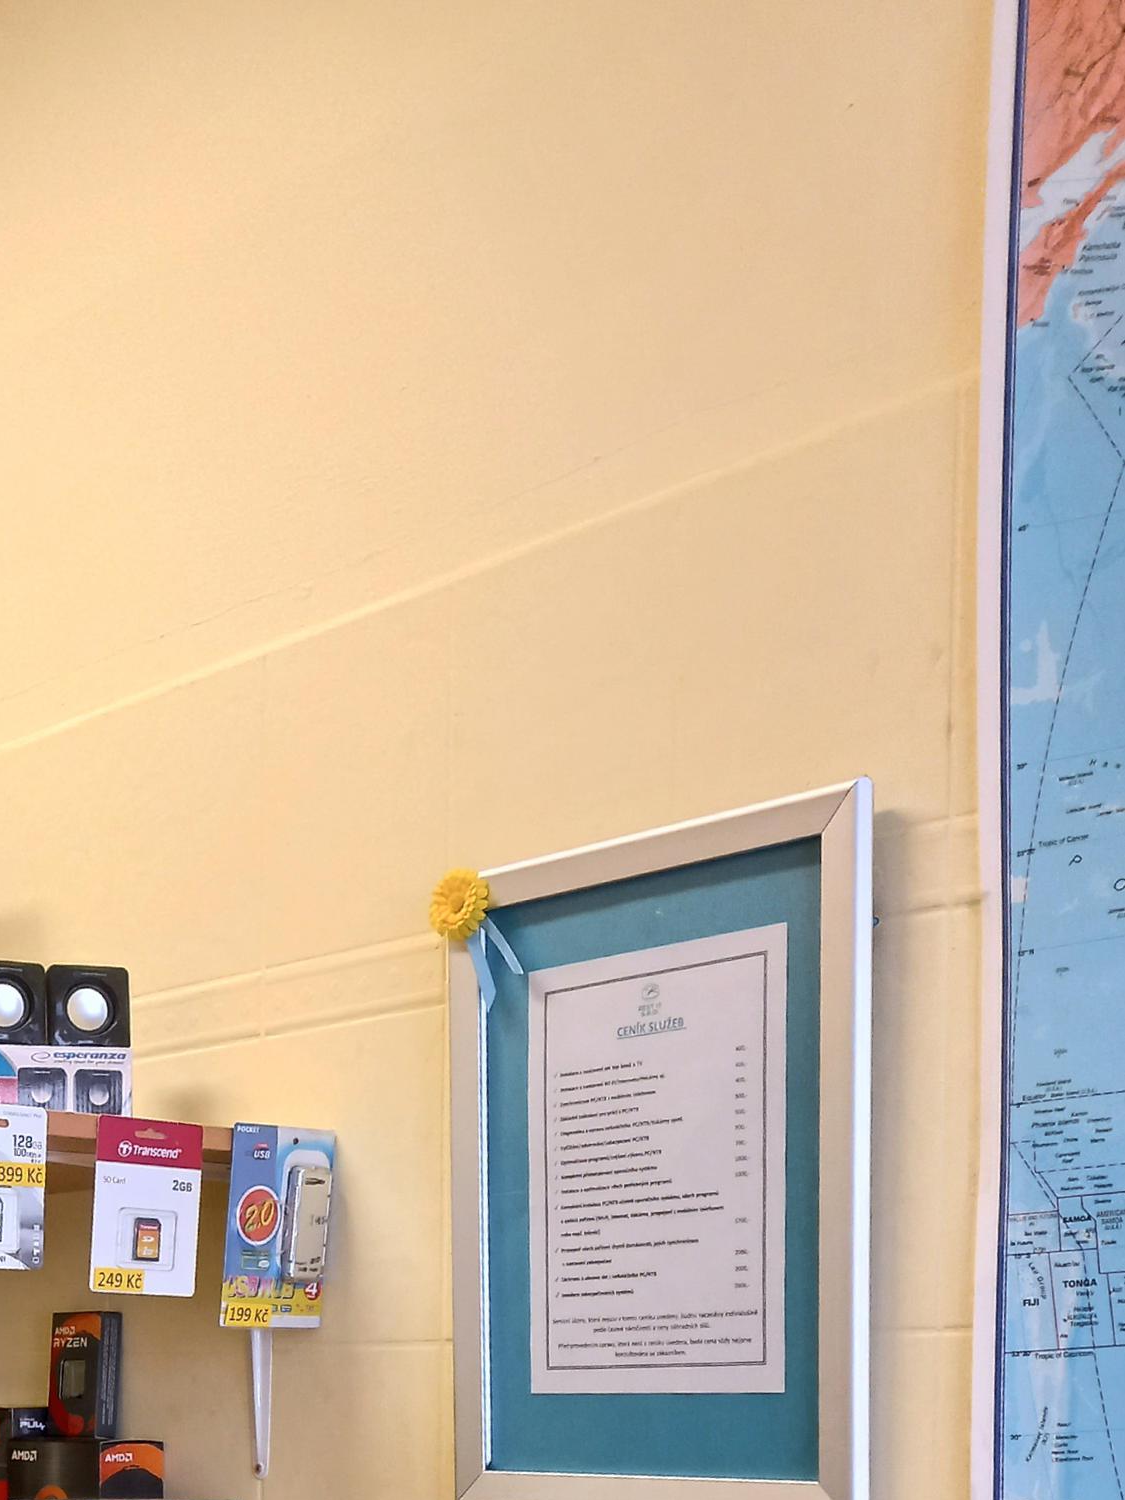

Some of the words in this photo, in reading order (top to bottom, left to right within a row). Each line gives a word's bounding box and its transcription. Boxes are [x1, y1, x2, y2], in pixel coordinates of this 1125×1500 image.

[617, 1019, 646, 1037] CENÍK
[647, 1016, 685, 1033] SLUŽEB
[53, 1050, 127, 1062] esperanza
[133, 1145, 179, 1159] Transcend
[253, 1150, 271, 1160] USB
[27, 1167, 44, 1184] Kč
[102, 1175, 112, 1184] SD
[113, 1175, 126, 1185] Card
[172, 1179, 193, 1193] 2GB
[244, 1200, 275, 1233] 2.0
[98, 1272, 123, 1288] 249
[126, 1273, 143, 1289] Kč
[1062, 1278, 1098, 1288] TONGA
[1023, 1299, 1040, 1307] FIJI
[229, 1307, 251, 1322] 199
[254, 1309, 269, 1323] Kč
[55, 1327, 70, 1336] AMD
[53, 1337, 88, 1348] RYZEN
[11, 1450, 31, 1461] AMD
[105, 1452, 127, 1462] AMD
